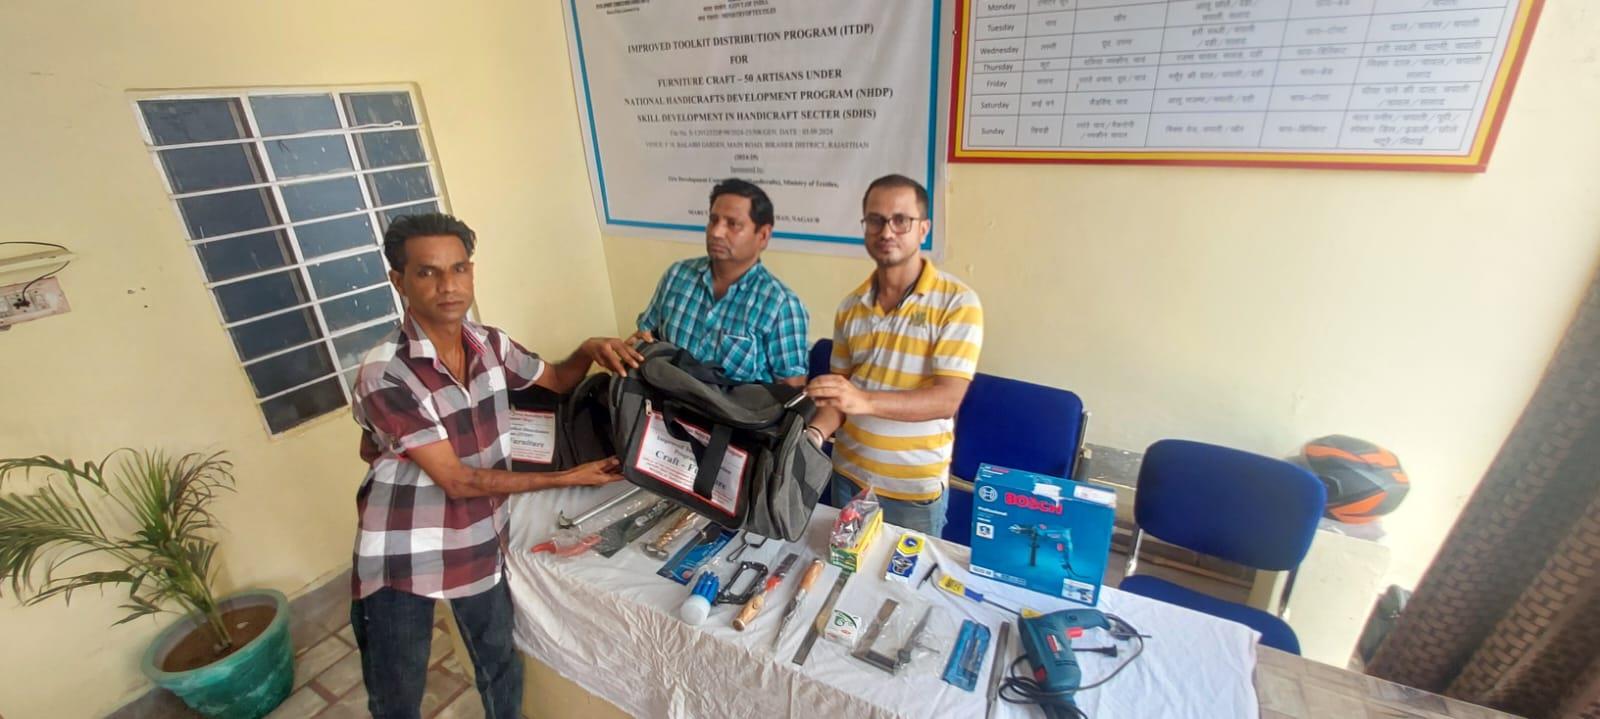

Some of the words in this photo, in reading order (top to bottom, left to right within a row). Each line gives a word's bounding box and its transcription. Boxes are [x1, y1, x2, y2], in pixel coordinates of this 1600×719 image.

[987, 4, 1016, 13] Monday
[987, 25, 1015, 33] Tuesday
[628, 43, 671, 54] IMPROVED
[672, 38, 710, 50] TOOLKIT
[713, 32, 781, 46] DISTRIBUTION
[784, 26, 837, 41] PROGRAM
[840, 23, 874, 38] (ITDP)
[980, 46, 1019, 55] Wednesday
[730, 55, 748, 64] FOR
[983, 63, 1013, 72] Thursday
[658, 77, 704, 87] FURNITURE
[706, 75, 736, 85] CRAFT
[744, 74, 754, 83] 50
[756, 71, 803, 82] ARTISANS
[806, 69, 842, 80] UNDER
[987, 80, 1008, 89] Friday
[624, 97, 663, 106] NATIONAL
[666, 94, 725, 105] HANDICRAFTS
[726, 91, 797, 103] DEVELOPMENT
[800, 88, 852, 100] PROGRAM
[856, 87, 893, 99] (NHDP)
[980, 101, 1010, 111] Saturday
[637, 114, 660, 123] SKILL
[662, 112, 723, 122] DEVELOPMENT
[725, 112, 734, 121] IN
[736, 110, 797, 121] HANDICRAFT
[801, 109, 840, 120] SECTER
[842, 108, 876, 120] (SDHS)
[981, 127, 1006, 137] Sunday
[655, 449, 680, 466] Craft
[1006, 491, 1063, 516] BOSCH
